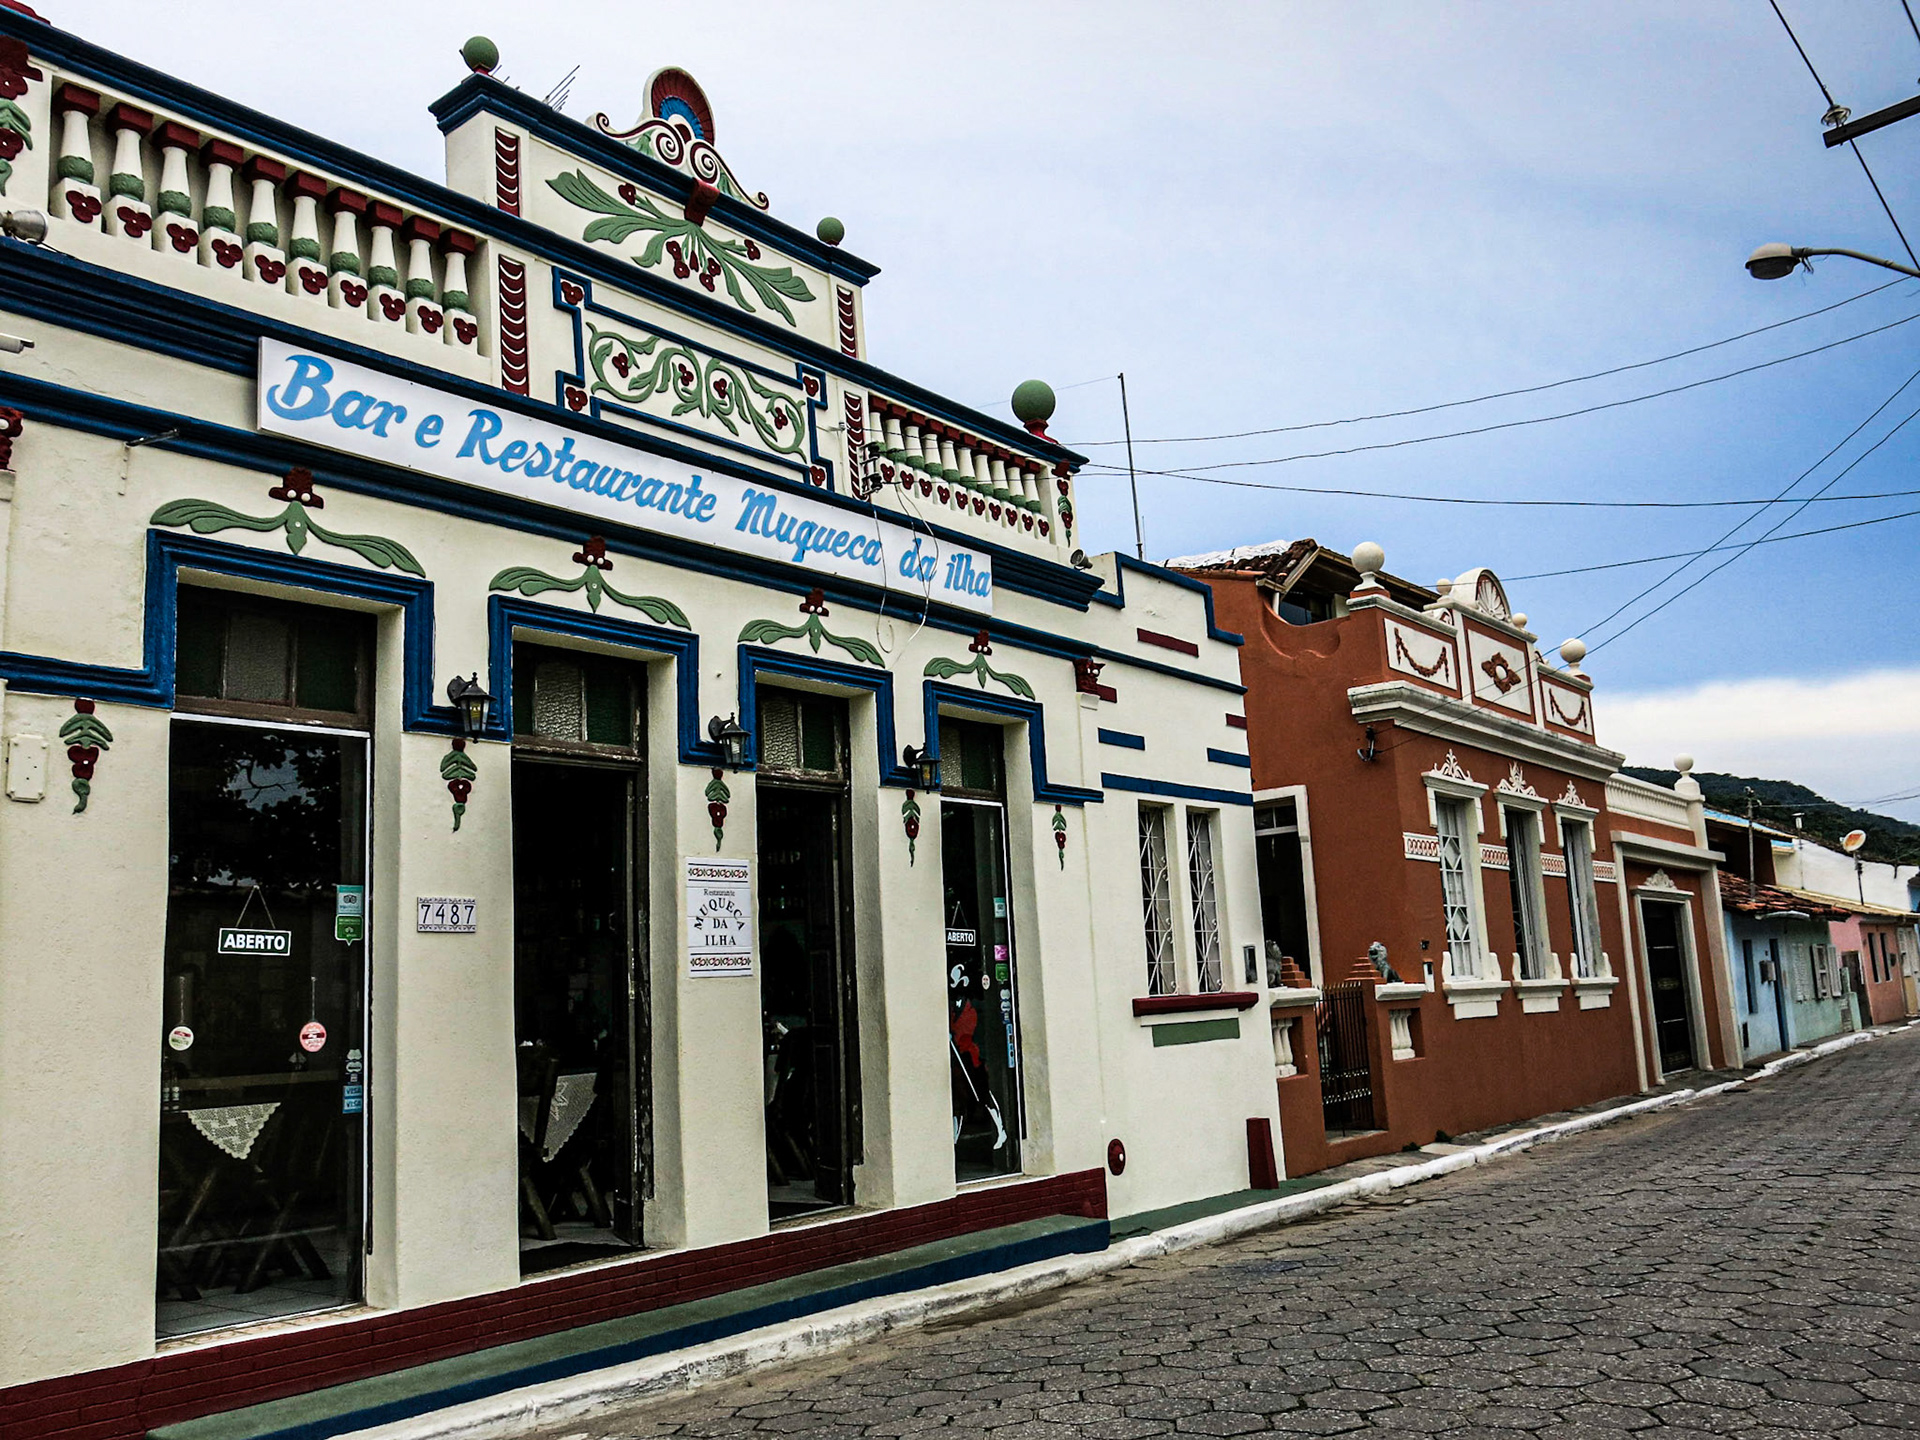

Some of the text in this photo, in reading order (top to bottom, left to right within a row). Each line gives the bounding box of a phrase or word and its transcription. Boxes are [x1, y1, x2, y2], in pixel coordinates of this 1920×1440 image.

[266, 353, 991, 599] Bar e Restaurante Muqueca da ilha
[420, 904, 475, 925] 7487
[694, 897, 745, 931] MUQUECA
[713, 918, 728, 929] DA
[223, 933, 285, 951] ABERTO
[705, 935, 737, 946] ILHA
[947, 931, 974, 943] ABERTO
